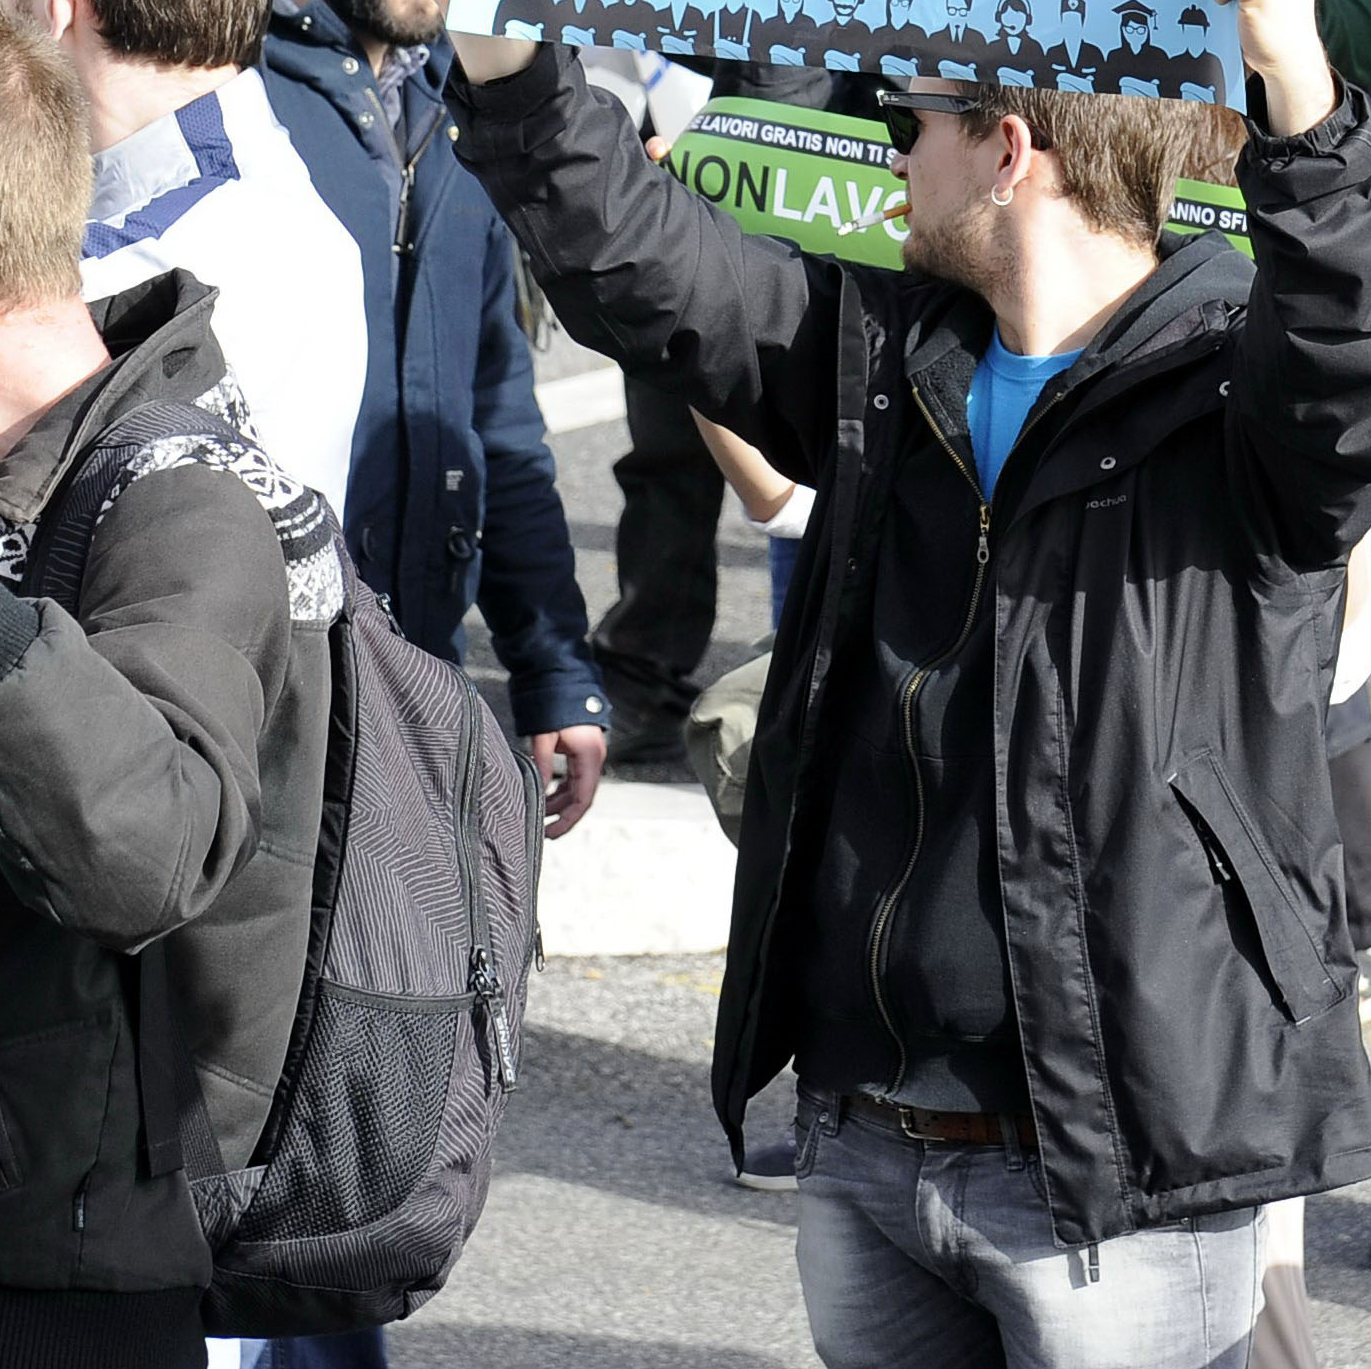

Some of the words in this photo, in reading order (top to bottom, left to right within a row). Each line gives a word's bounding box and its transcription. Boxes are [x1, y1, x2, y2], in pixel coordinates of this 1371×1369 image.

[703, 115, 758, 139] LAVORI
[760, 124, 823, 152] GRATIS
[825, 137, 864, 159] NON
[867, 144, 883, 163] TI
